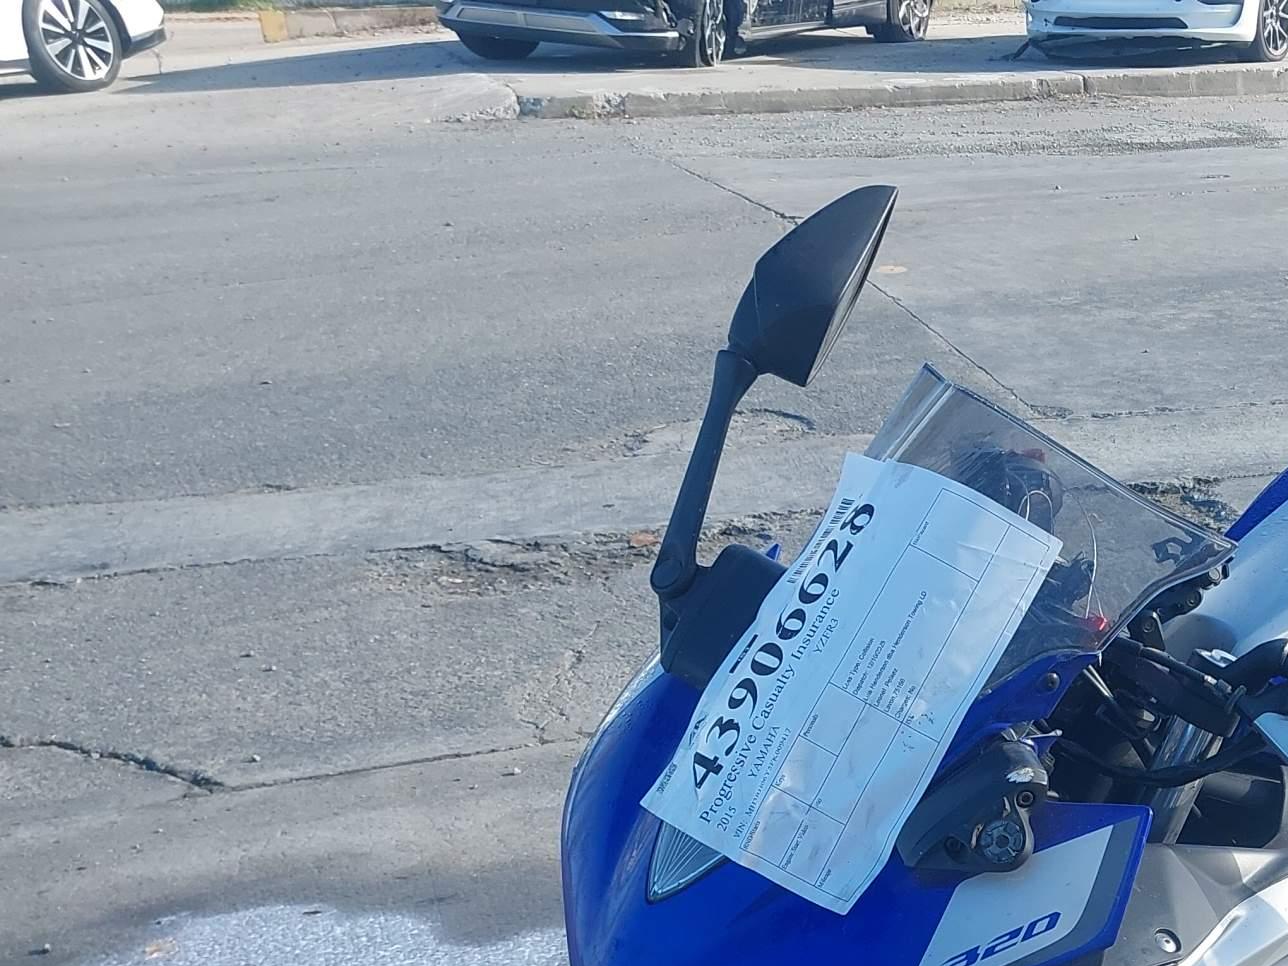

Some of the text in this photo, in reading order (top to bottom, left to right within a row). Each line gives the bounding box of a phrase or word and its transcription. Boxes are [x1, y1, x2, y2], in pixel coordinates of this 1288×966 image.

[693, 502, 874, 789] 43906628
[699, 588, 840, 824] Progressive Casualty Insurance
[716, 617, 839, 832] 2015 YAMAHA YZFR3
[891, 618, 911, 649] Henderson
[908, 599, 923, 618] Towing
